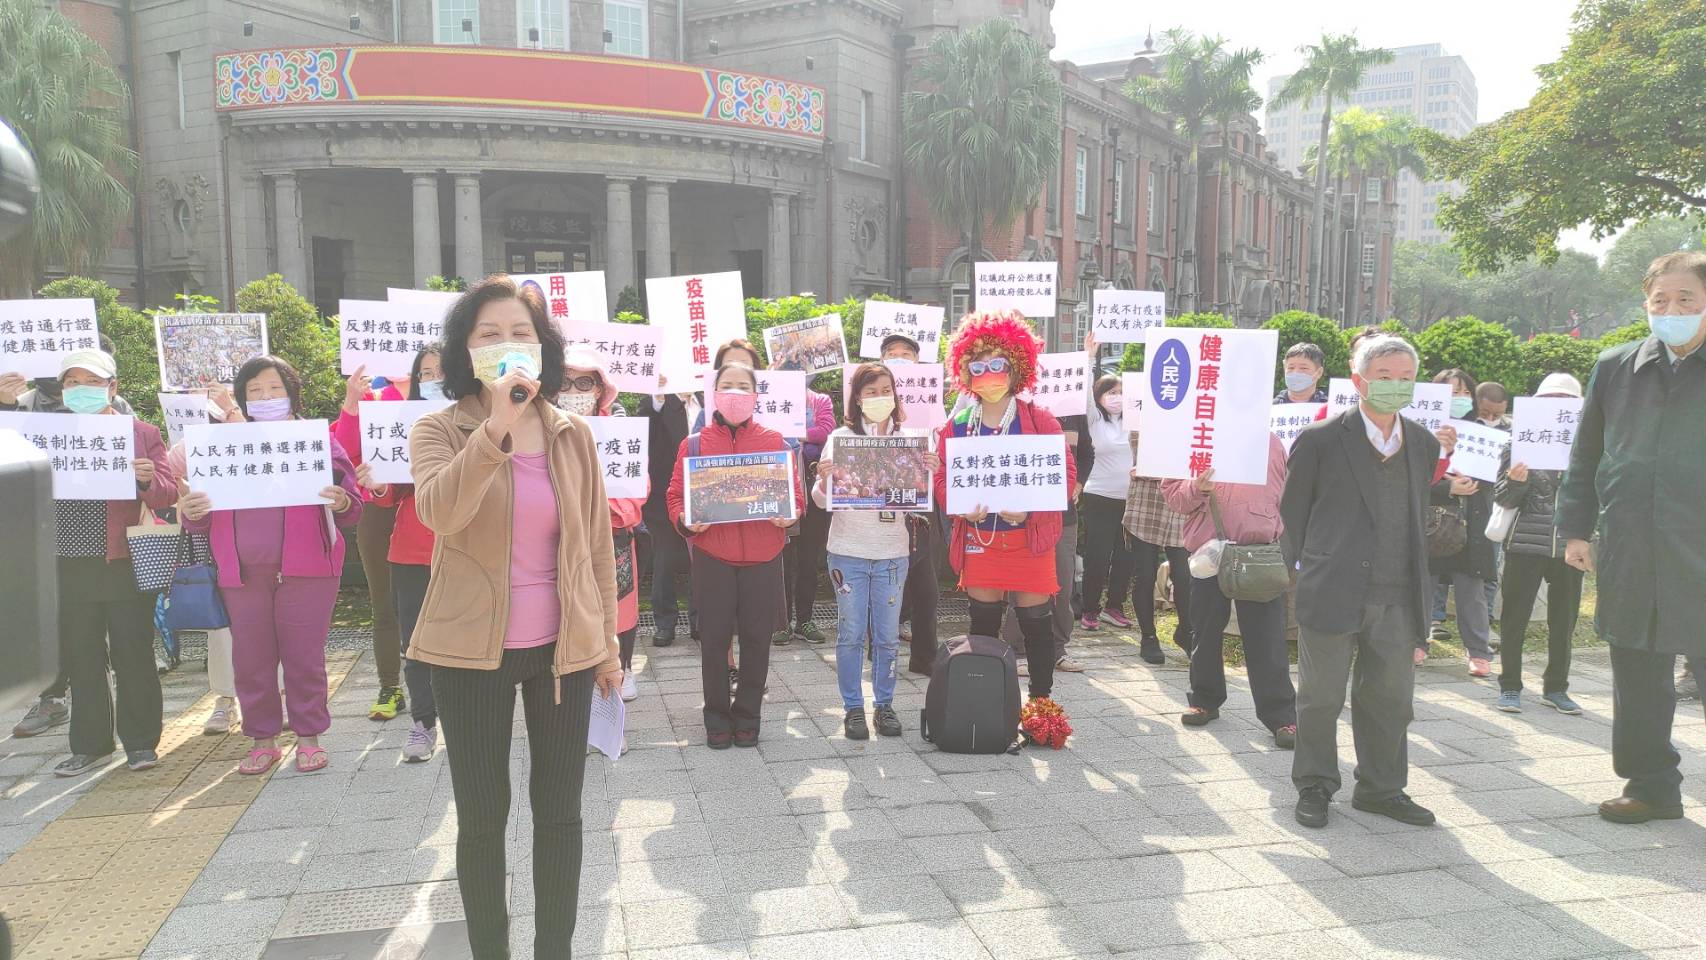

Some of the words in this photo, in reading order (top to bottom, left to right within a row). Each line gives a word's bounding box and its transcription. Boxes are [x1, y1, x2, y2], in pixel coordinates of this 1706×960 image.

[549, 275, 569, 318] 用藥
[894, 312, 918, 326] 抗議
[609, 361, 656, 377] 決定權
[1160, 347, 1181, 402] 人民有
[1189, 334, 1223, 478] 健康自主權
[190, 440, 323, 457] 人民有用藥選擇權
[369, 446, 409, 463] 人民
[192, 459, 325, 477] 人民有健康自主權
[606, 460, 642, 478] 定權
[951, 453, 1062, 469] 反對疫苗通行證
[951, 472, 1062, 488] 反對健康通行證
[886, 487, 917, 504] 美國
[747, 500, 779, 515] 法國
